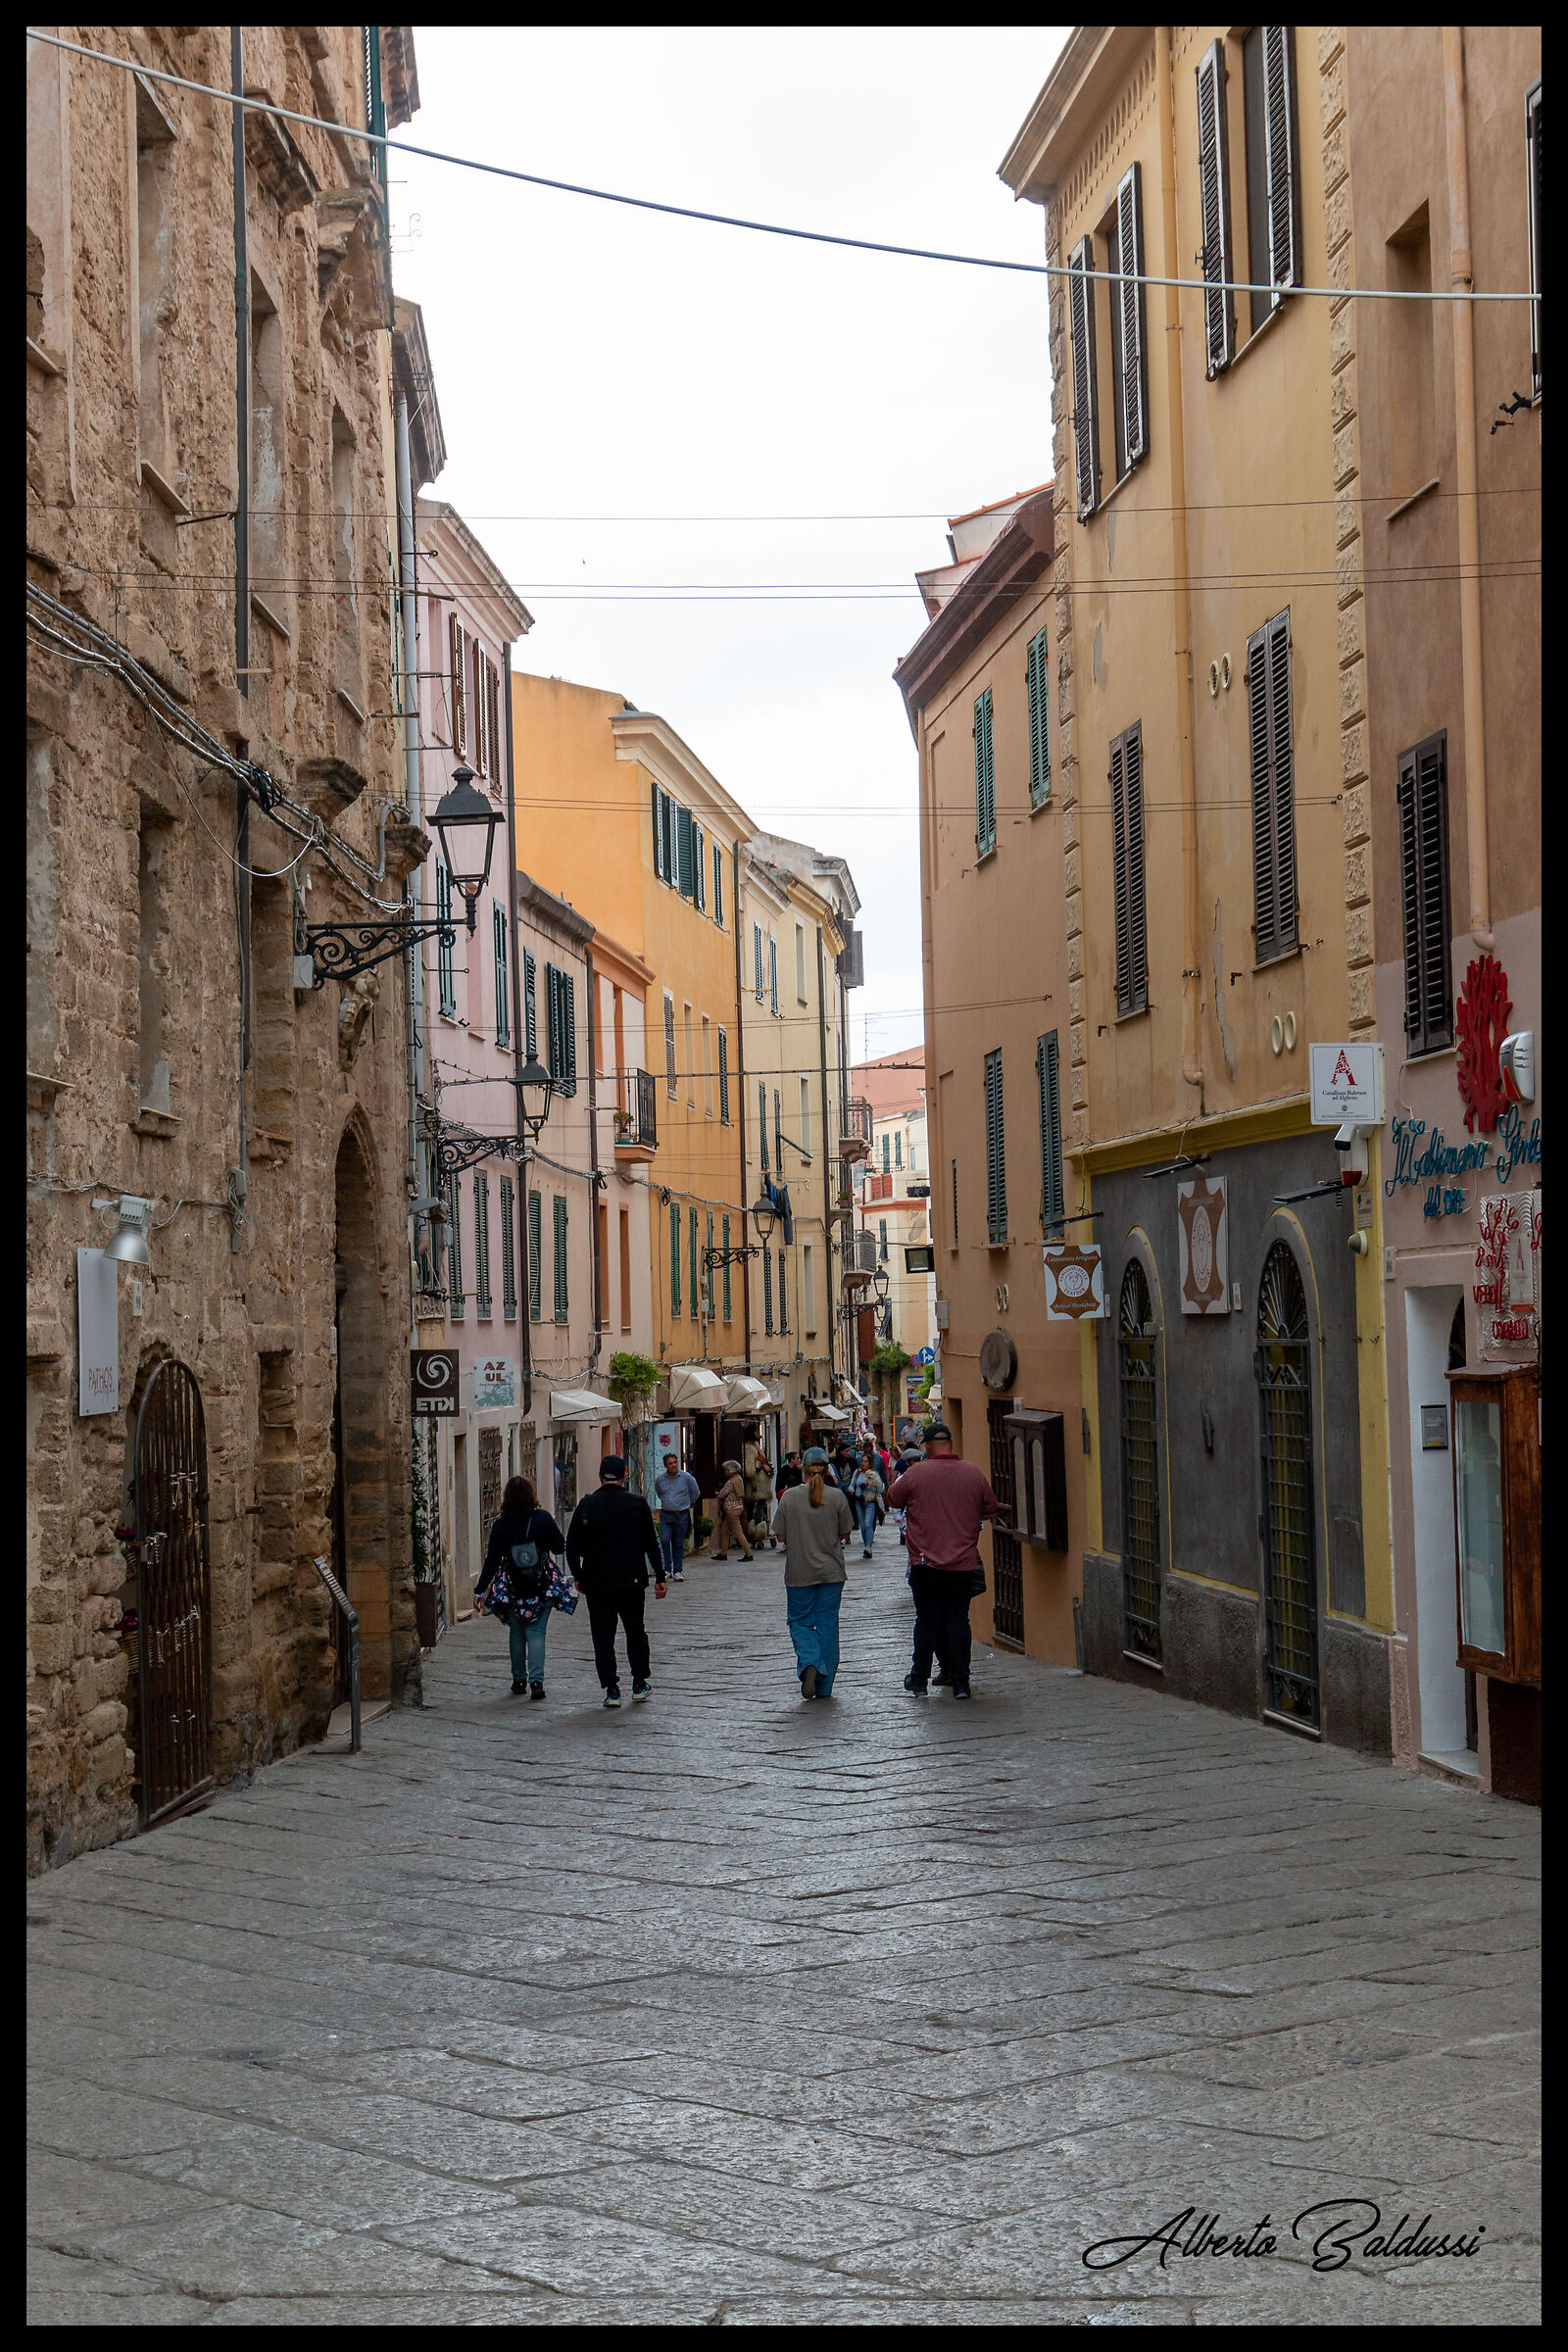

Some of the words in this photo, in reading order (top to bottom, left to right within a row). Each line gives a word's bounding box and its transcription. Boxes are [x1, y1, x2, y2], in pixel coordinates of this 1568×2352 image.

[483, 1361, 506, 1371] AZ
[88, 1366, 113, 1391] PATHOS
[485, 1373, 506, 1382] UL
